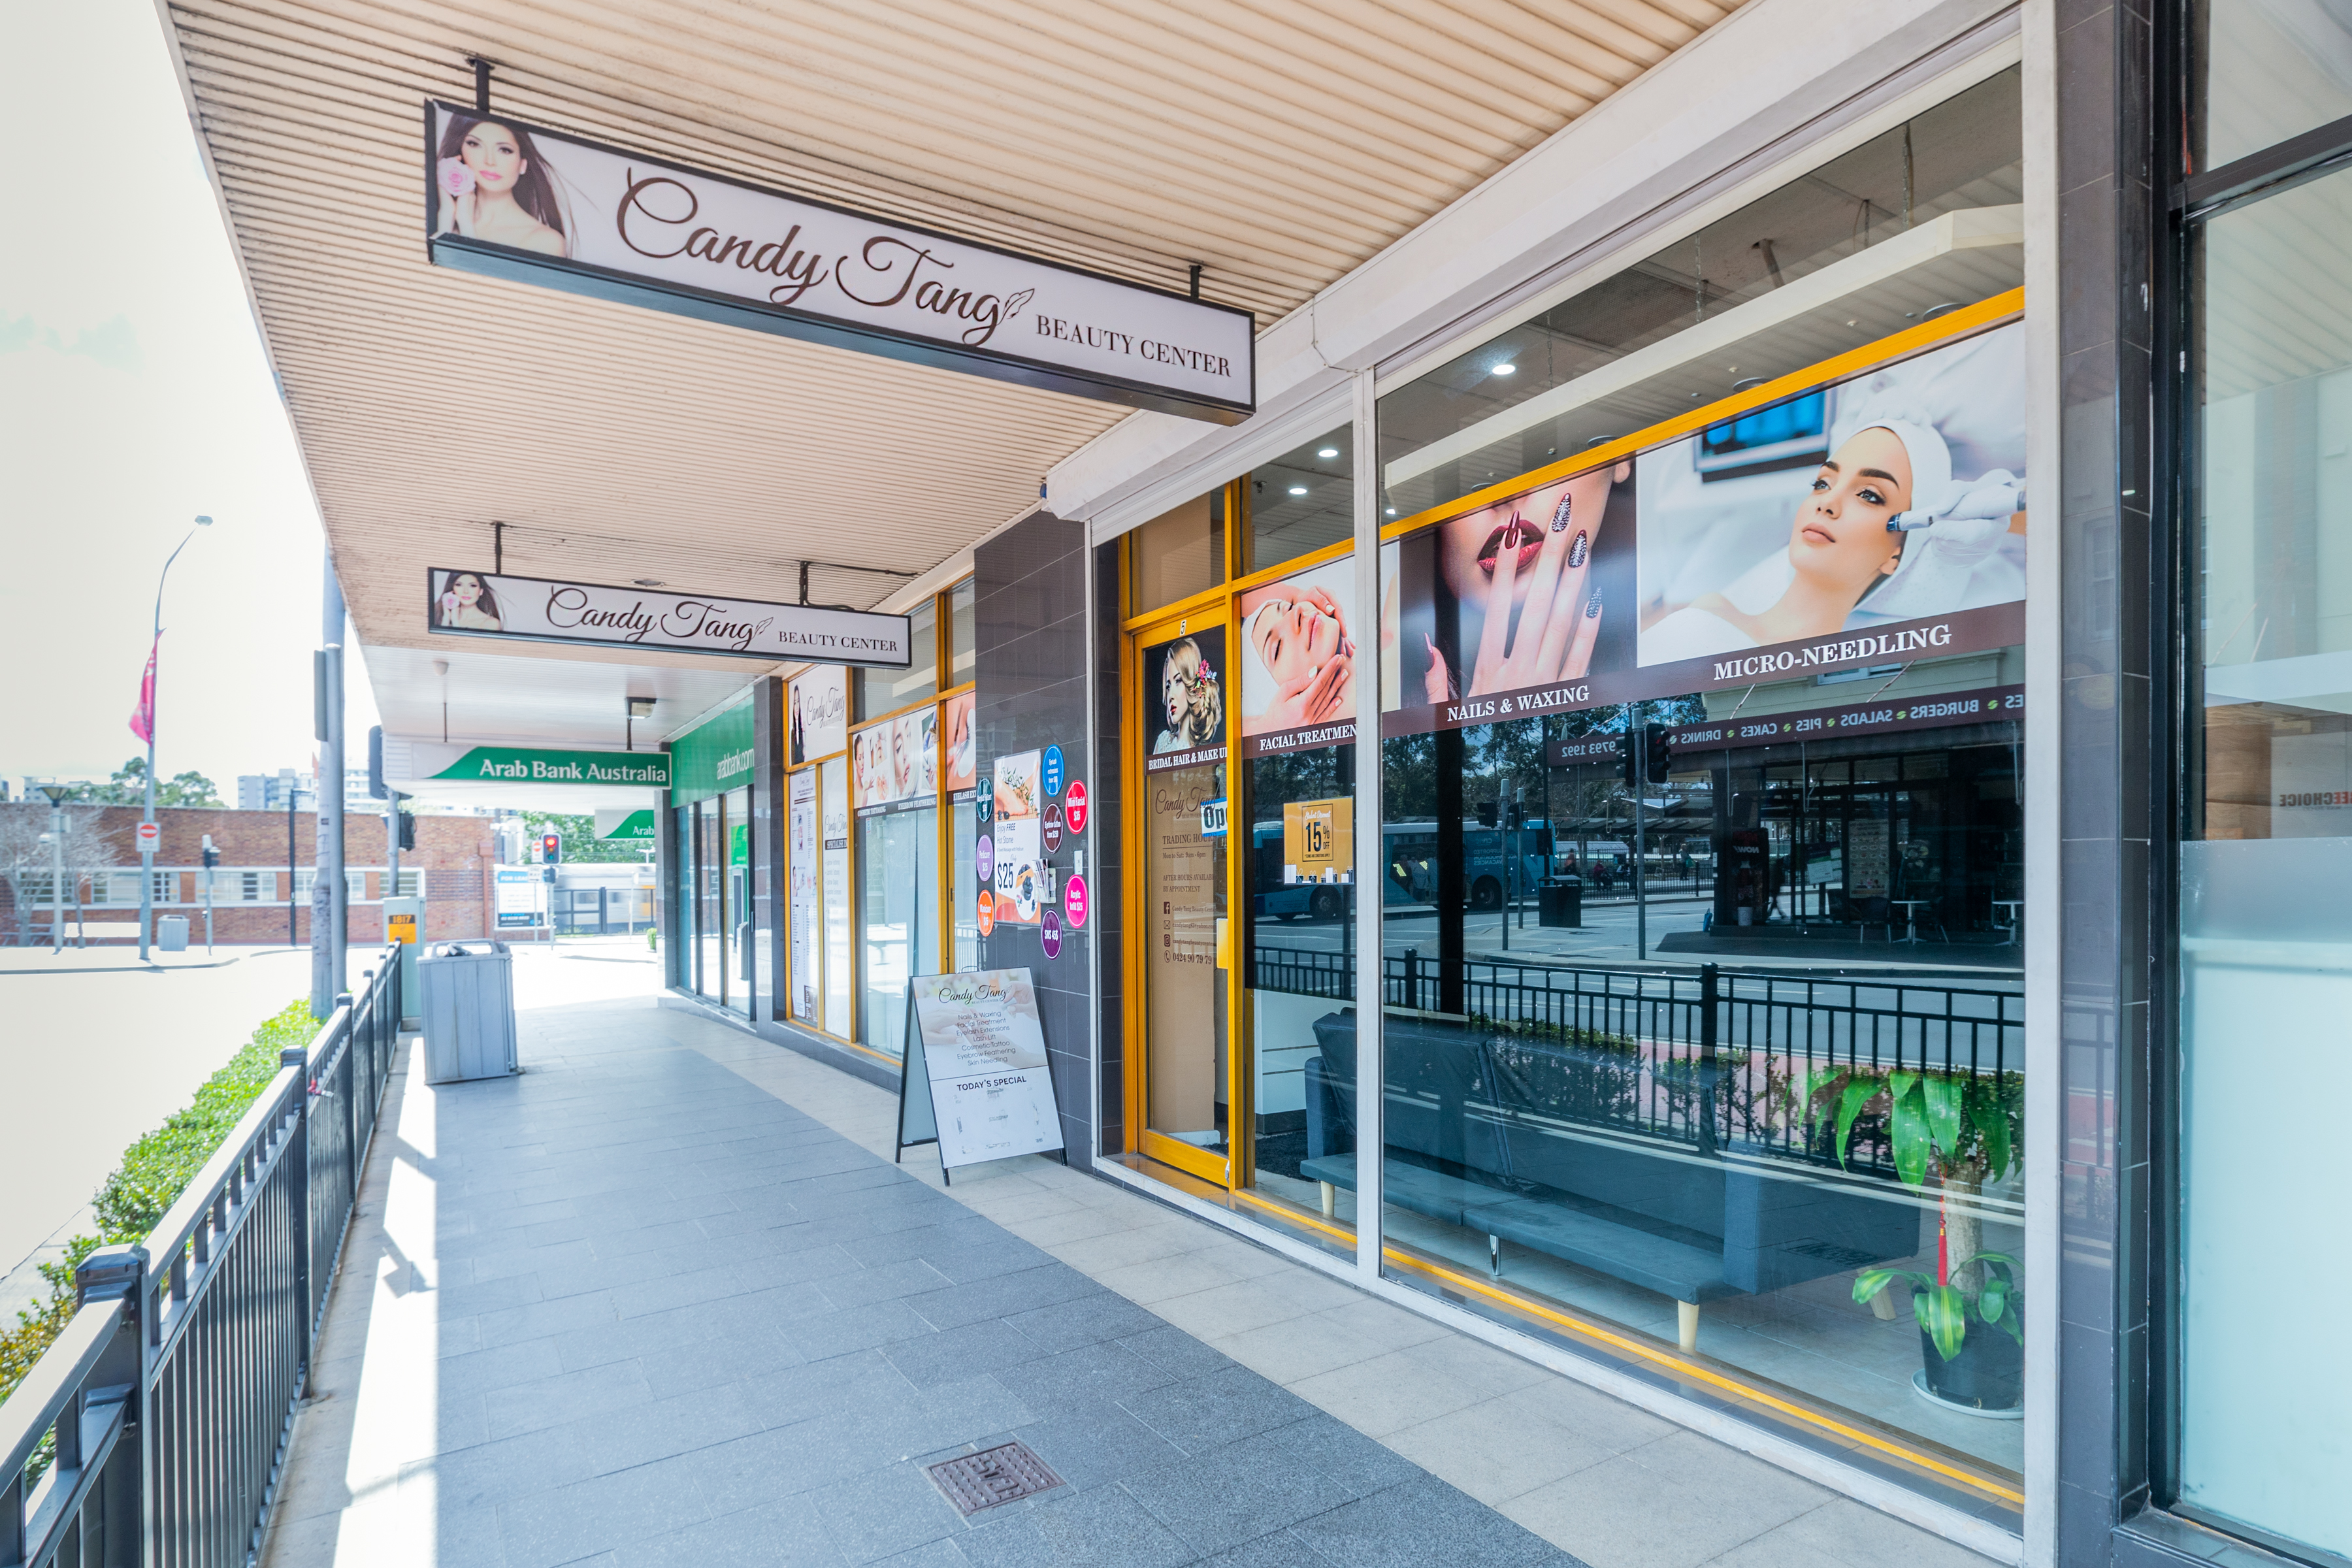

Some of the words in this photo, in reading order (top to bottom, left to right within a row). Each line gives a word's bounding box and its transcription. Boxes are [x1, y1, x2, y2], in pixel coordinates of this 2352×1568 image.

[617, 167, 828, 306] Candy
[836, 236, 1001, 346] Tang
[1035, 314, 1134, 356] BEAUTY
[1140, 340, 1232, 378] CENTER
[546, 585, 657, 643] Candy
[660, 601, 756, 651] Tang
[1181, 621, 1186, 634] 5
[778, 632, 838, 648] BEAUTY
[841, 636, 898, 652] CENTER
[1713, 623, 1952, 681] MICRO-NEEDLING
[806, 696, 825, 728] Candy
[1446, 700, 1495, 722] NAILS
[1500, 698, 1513, 715] &
[1516, 685, 1590, 711] WAXING
[1260, 734, 1296, 751] FACIAL
[717, 748, 755, 780] arabbank.com
[1149, 757, 1173, 770] BRIDAL
[1173, 753, 1190, 766] HAIR
[1190, 752, 1197, 763] &
[1197, 748, 1218, 762] MAKE
[479, 759, 529, 779] Arab
[532, 760, 583, 780] Bank
[587, 762, 666, 783] Australia
[1155, 789, 1184, 819] Candy
[996, 825, 1006, 834] Enjoy
[1006, 823, 1016, 831] FREE
[1203, 806, 1228, 830] Op
[632, 825, 655, 836] Arab
[1003, 836, 1014, 844] Stone
[1162, 834, 1191, 845] TRADING
[1306, 821, 1322, 852] 15
[1323, 826, 1330, 839] %
[997, 861, 1013, 890] $25
[393, 915, 412, 923] 1817
[1173, 953, 1186, 962] 0424
[1188, 954, 1195, 963] 90
[1196, 955, 1203, 964] 79
[1205, 955, 1212, 964] 79
[939, 987, 974, 1005] Candy
[975, 985, 1007, 1002] Tang
[984, 1047, 1016, 1056] Feathering
[956, 1079, 992, 1091] TODAY'S
[993, 1076, 1027, 1086] SPECIAL
